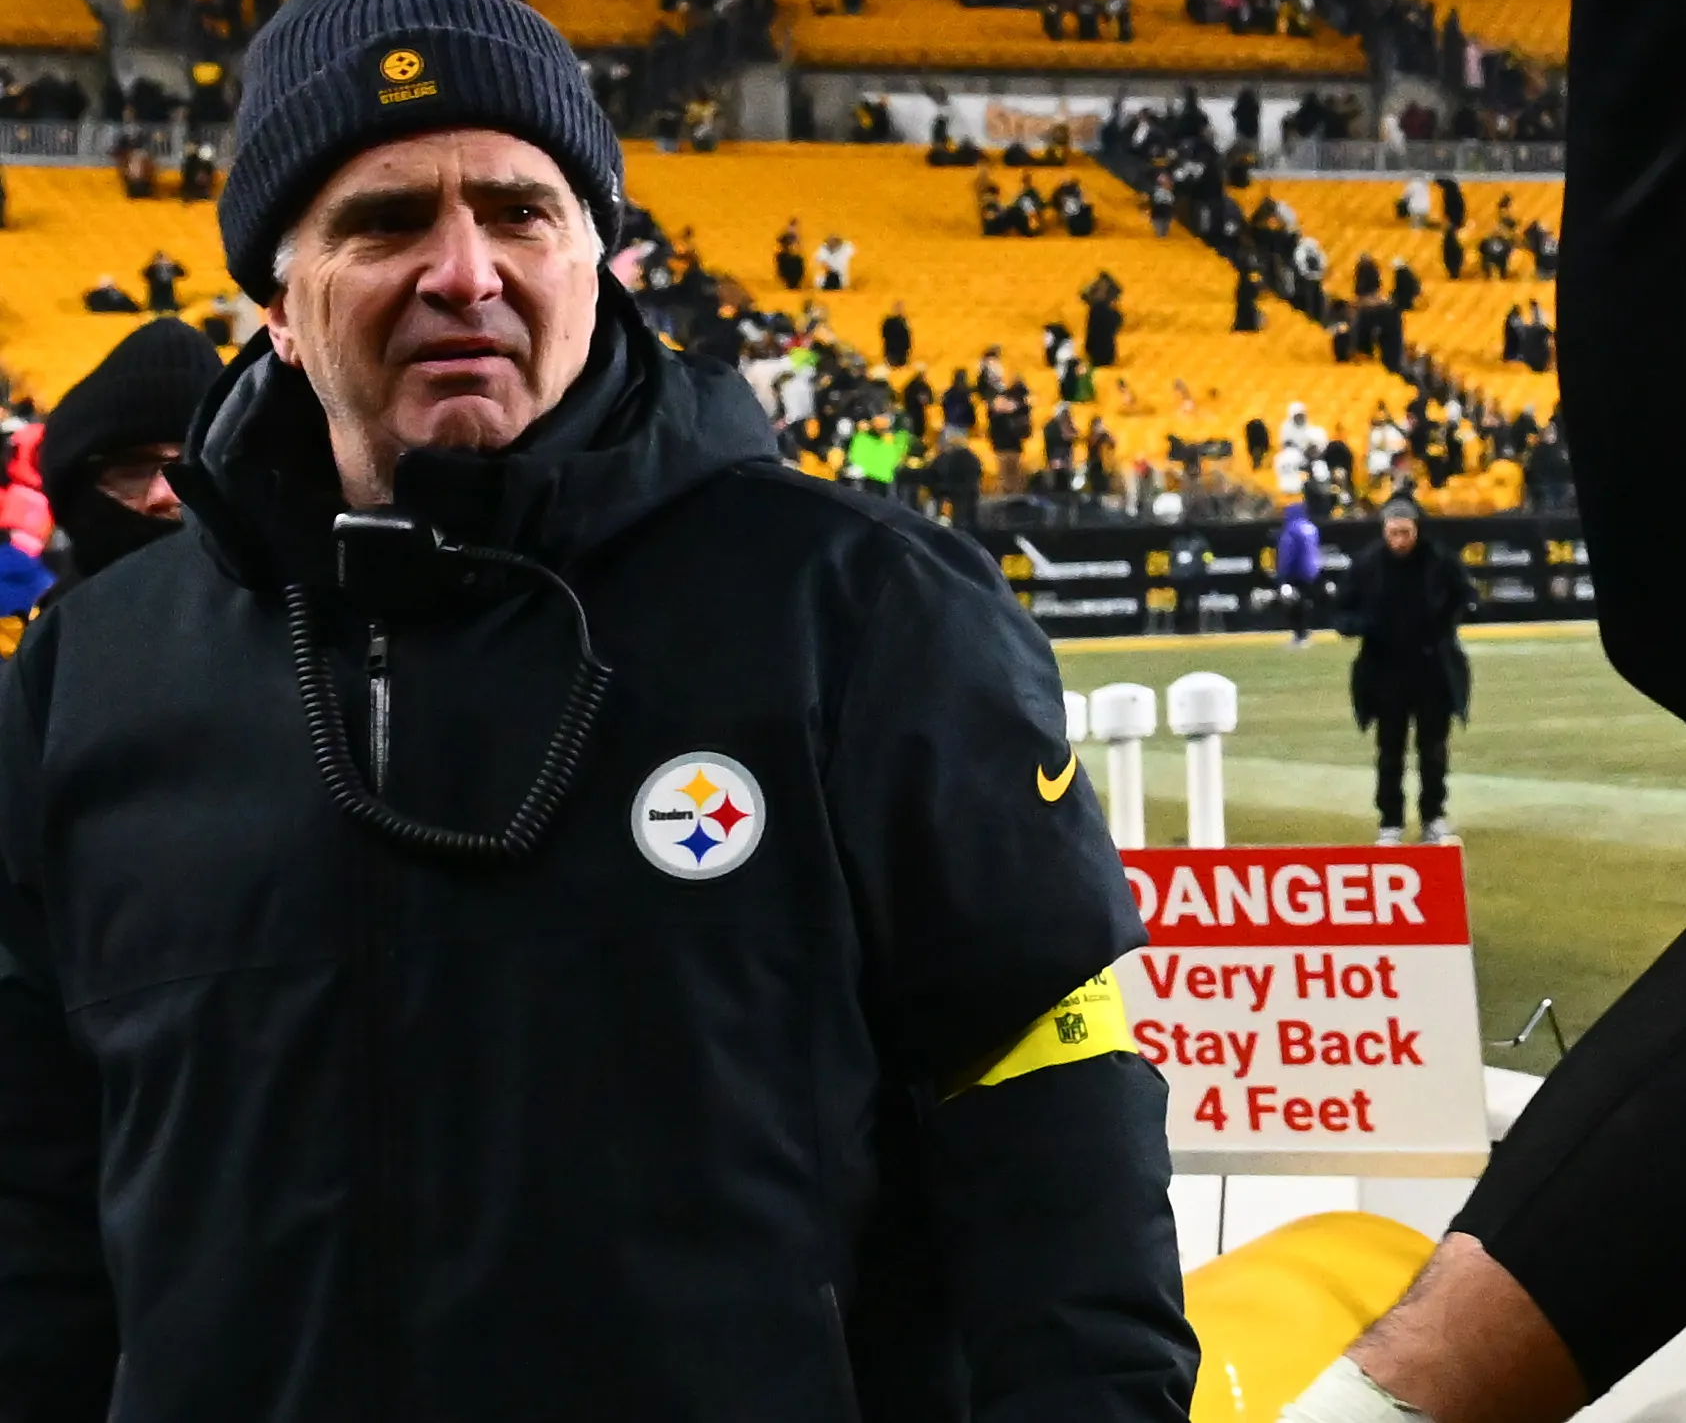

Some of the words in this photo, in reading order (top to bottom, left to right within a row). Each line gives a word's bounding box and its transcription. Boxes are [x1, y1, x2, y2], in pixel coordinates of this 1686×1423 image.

[648, 808, 694, 822] Steelers
[1140, 952, 1275, 1013] Very
[1293, 952, 1400, 1000] Hot
[1132, 1019, 1258, 1079] Stay
[1277, 1016, 1424, 1067] Back
[1194, 1085, 1228, 1133] 4
[1246, 1084, 1375, 1134] Feet
